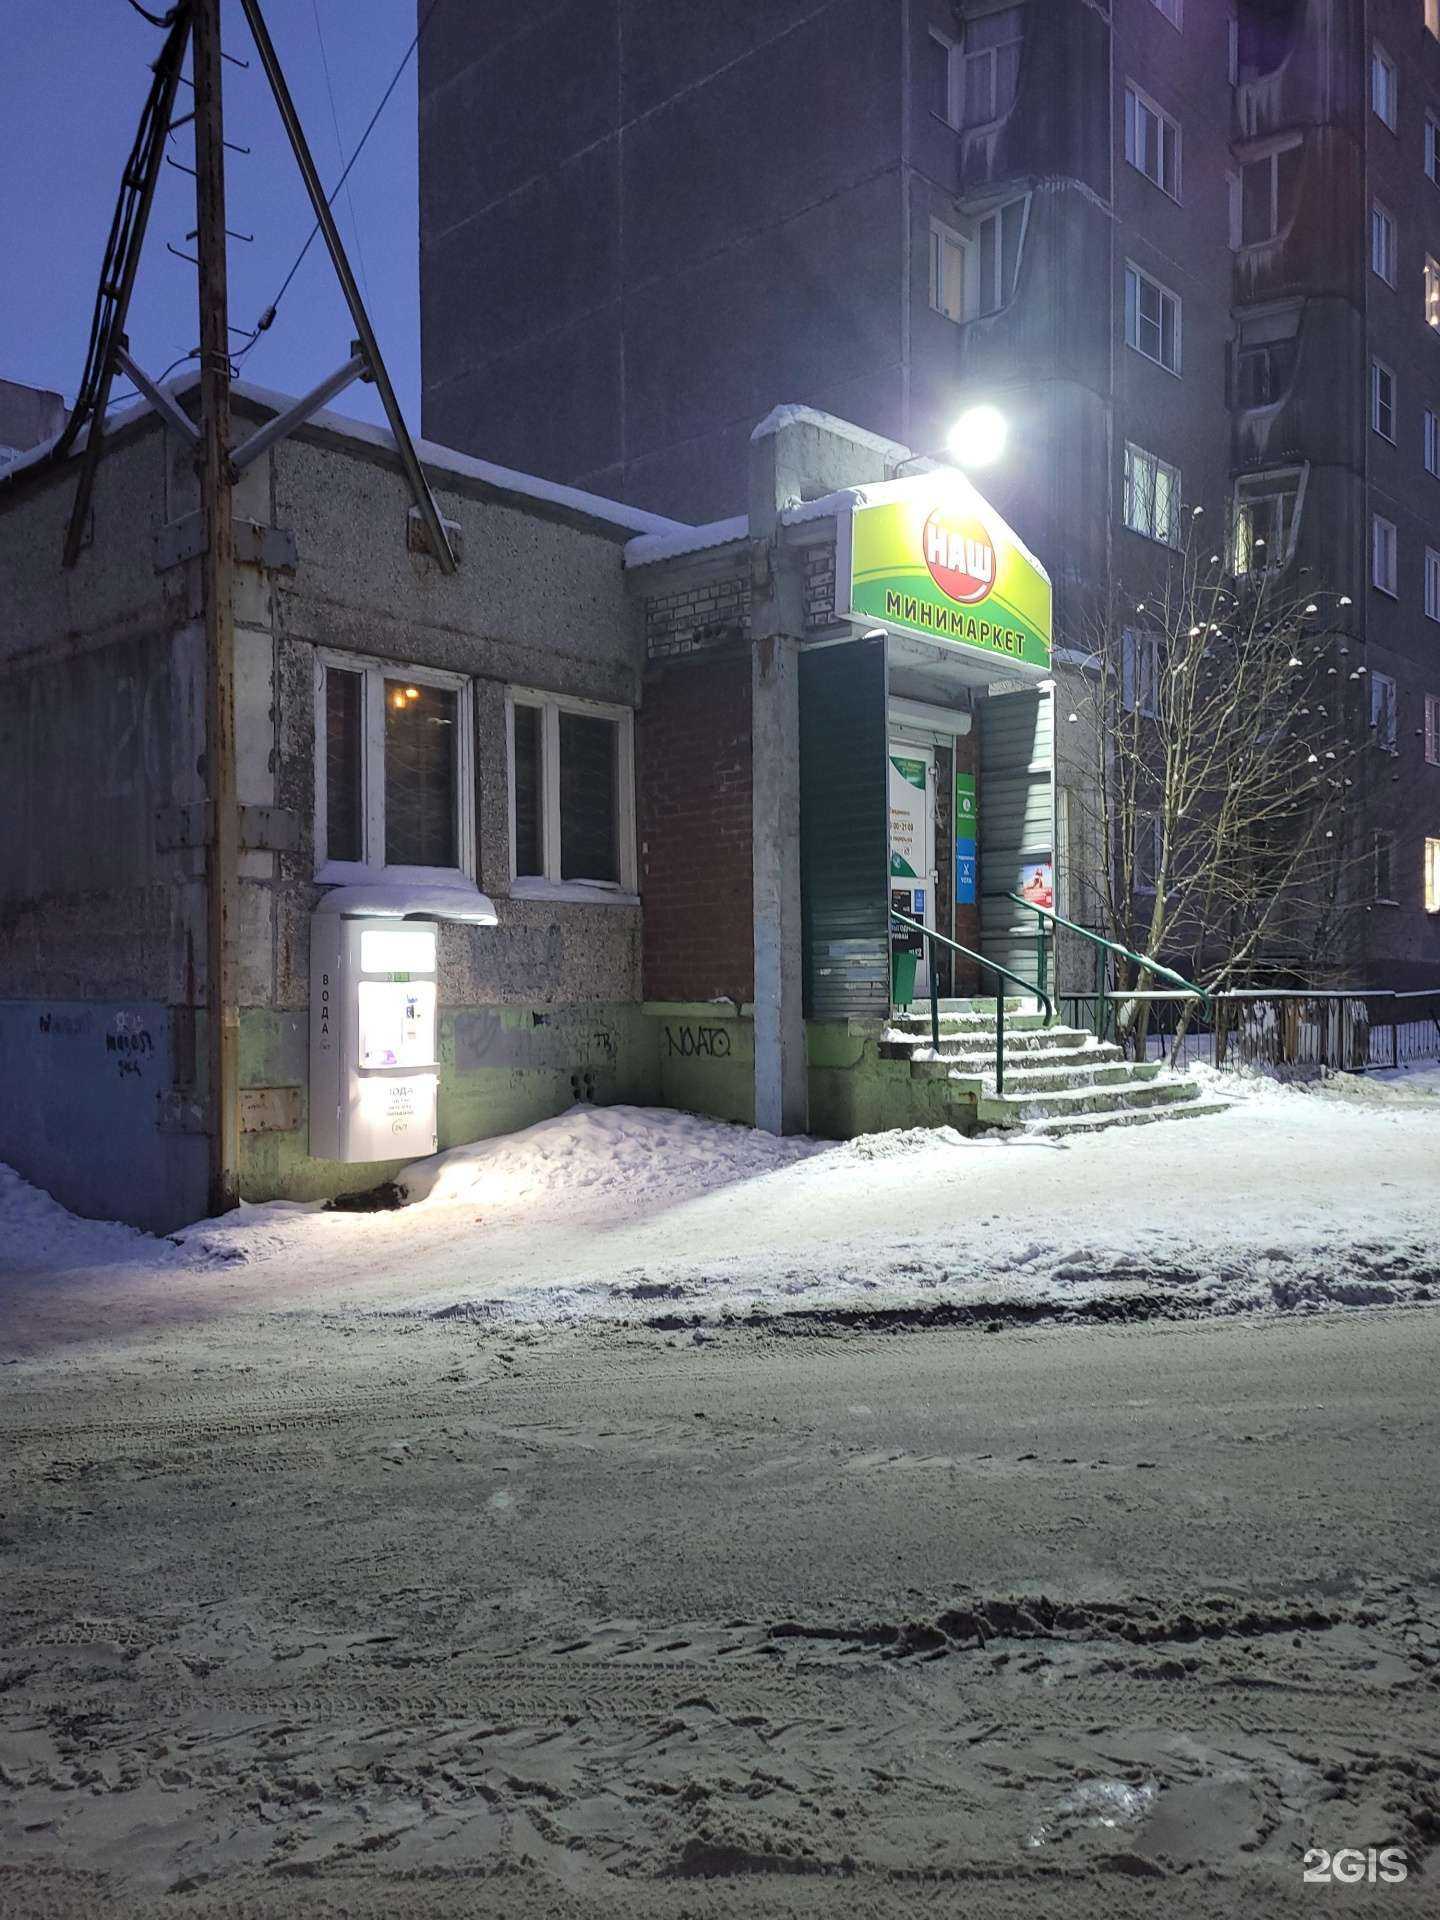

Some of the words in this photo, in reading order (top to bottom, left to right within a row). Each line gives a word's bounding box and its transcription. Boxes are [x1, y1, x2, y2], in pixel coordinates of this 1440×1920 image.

[927, 522, 993, 584] НАШ
[885, 588, 1026, 656] МИНИМАРКЕТ
[321, 973, 330, 1035] ВОДА
